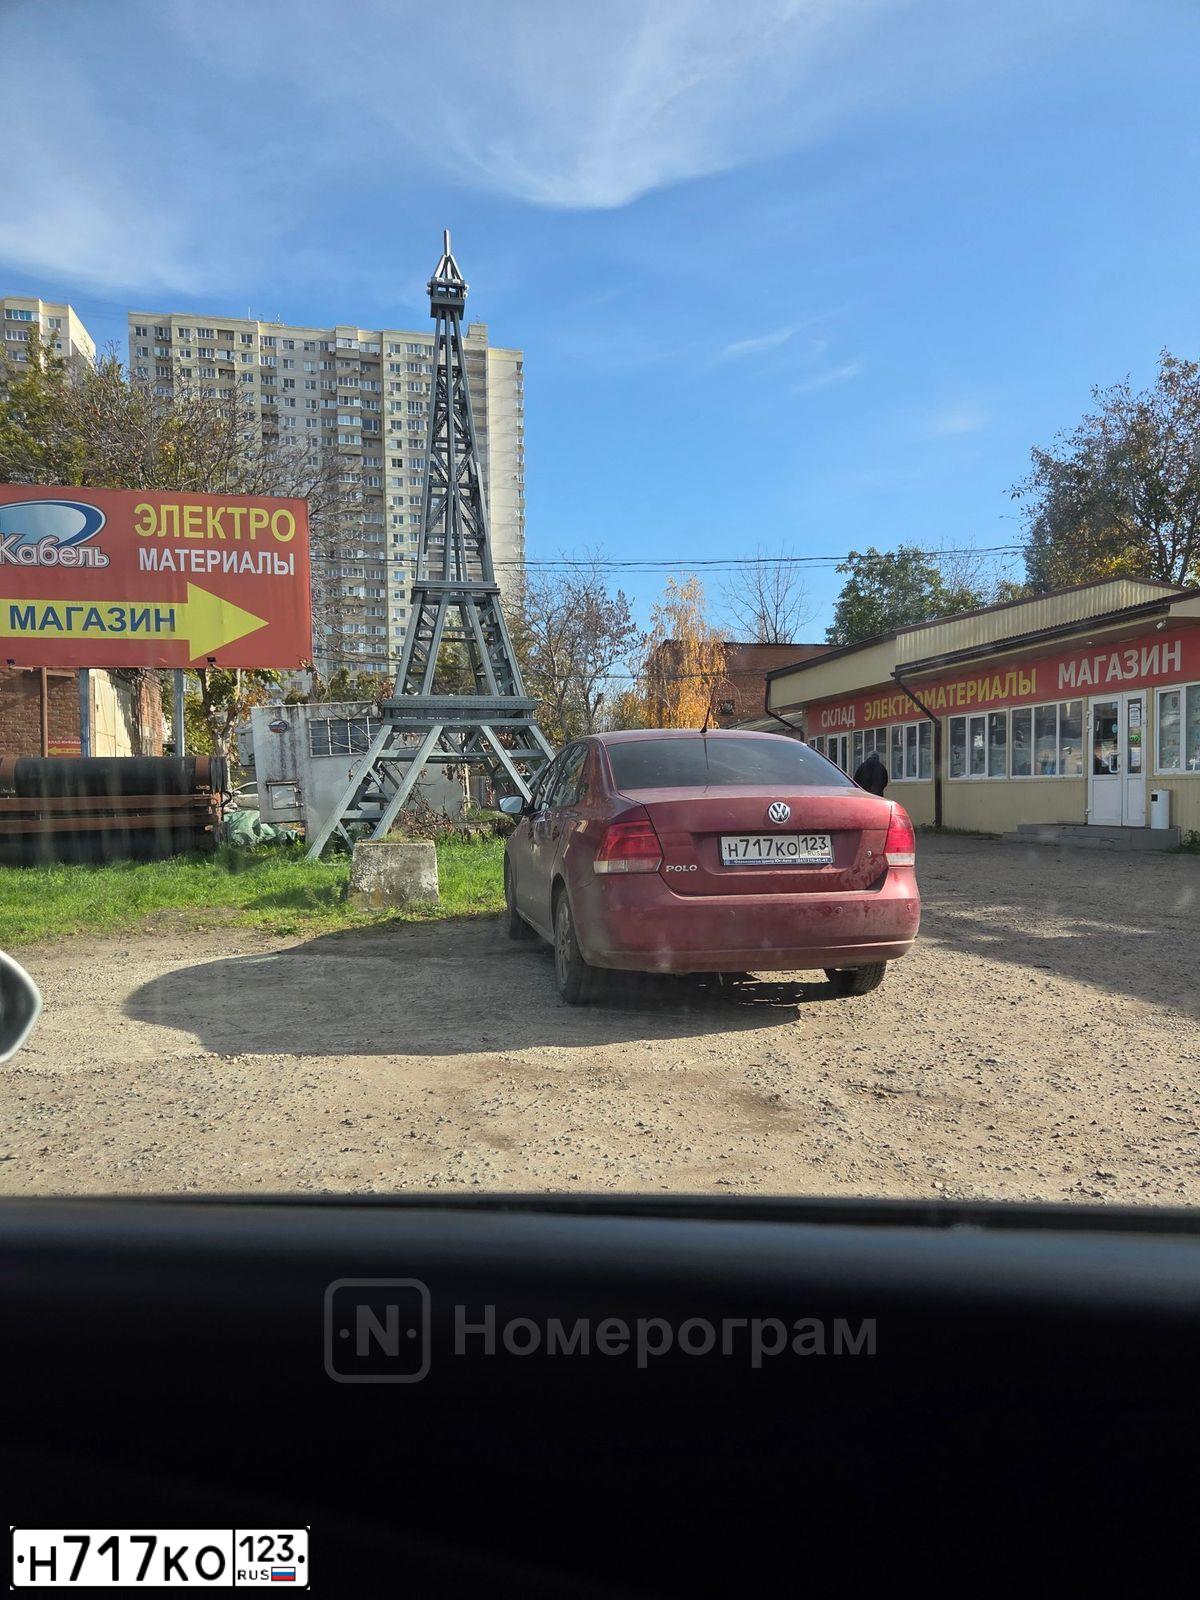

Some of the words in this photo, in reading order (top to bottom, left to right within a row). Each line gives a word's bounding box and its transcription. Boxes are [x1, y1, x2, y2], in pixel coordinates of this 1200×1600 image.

[134, 503, 296, 542] ЭЛЕКТРО
[0, 533, 110, 568] Кабель
[139, 548, 295, 576] МАТЕРИАЛЫ
[9, 605, 175, 632] МАГАЗИН
[821, 704, 856, 728] СКЛАД
[1058, 640, 1182, 690] МАГАЗИН
[728, 838, 798, 857] Н717КО
[801, 836, 826, 850] 123
[666, 864, 698, 872] POLO
